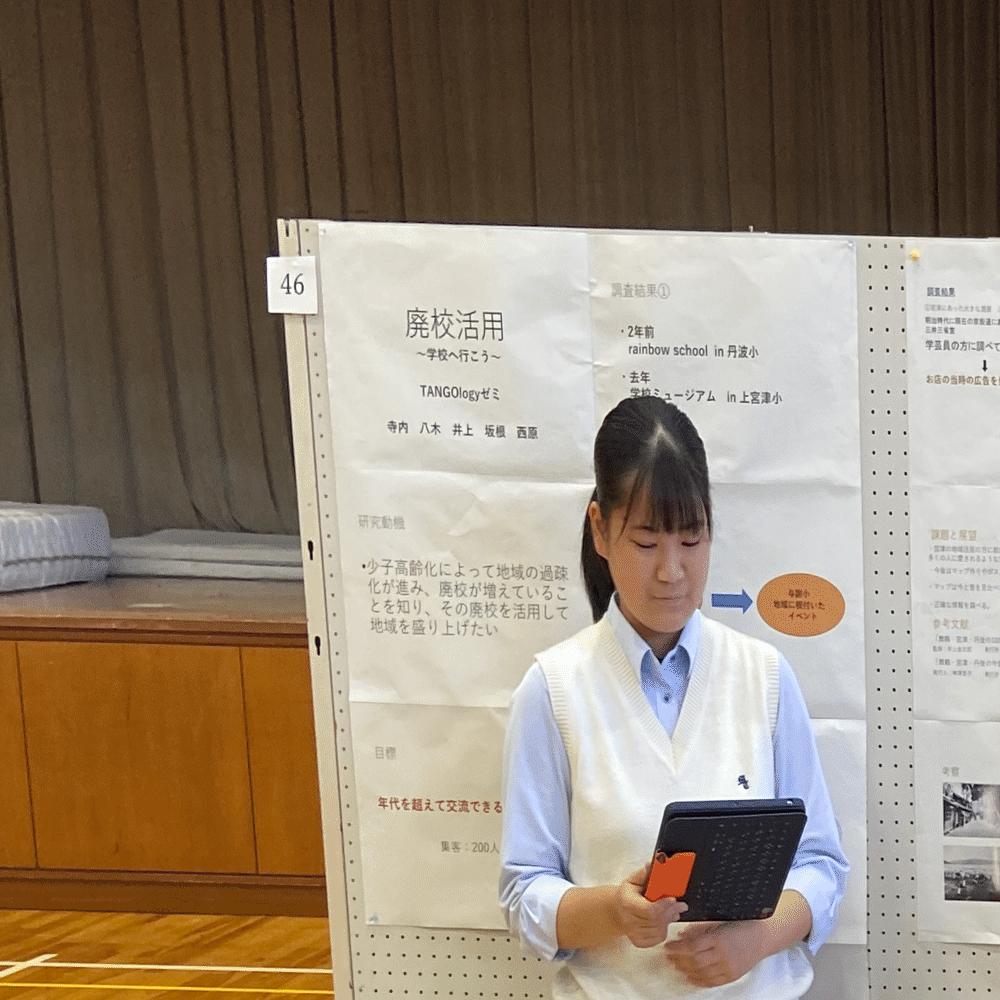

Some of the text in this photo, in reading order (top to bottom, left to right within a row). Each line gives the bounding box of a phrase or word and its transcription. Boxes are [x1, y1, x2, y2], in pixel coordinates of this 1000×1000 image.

[280, 273, 305, 295] 46
[611, 282, 670, 299] 調査結果①
[405, 307, 505, 341] 廃校活用
[628, 344, 759, 358] rainbow school in 丹波小
[420, 385, 500, 401] TANGOlogyゼミ
[727, 391, 736, 403] in
[739, 391, 782, 405] 上宮津小
[387, 421, 539, 440] 寺内 八木 井上 坂根 西原
[358, 514, 405, 530] 研究動機
[367, 580, 568, 602] 化が進み、廃校が増えているこ
[370, 600, 569, 621] とを知り、その廃校を活用して
[788, 612, 817, 621] イベント
[370, 619, 498, 637] 地域を盛り上げたい
[933, 618, 969, 630] 参考文献
[375, 746, 397, 760] 目標
[378, 797, 503, 814] 年代を超えて交流できる
